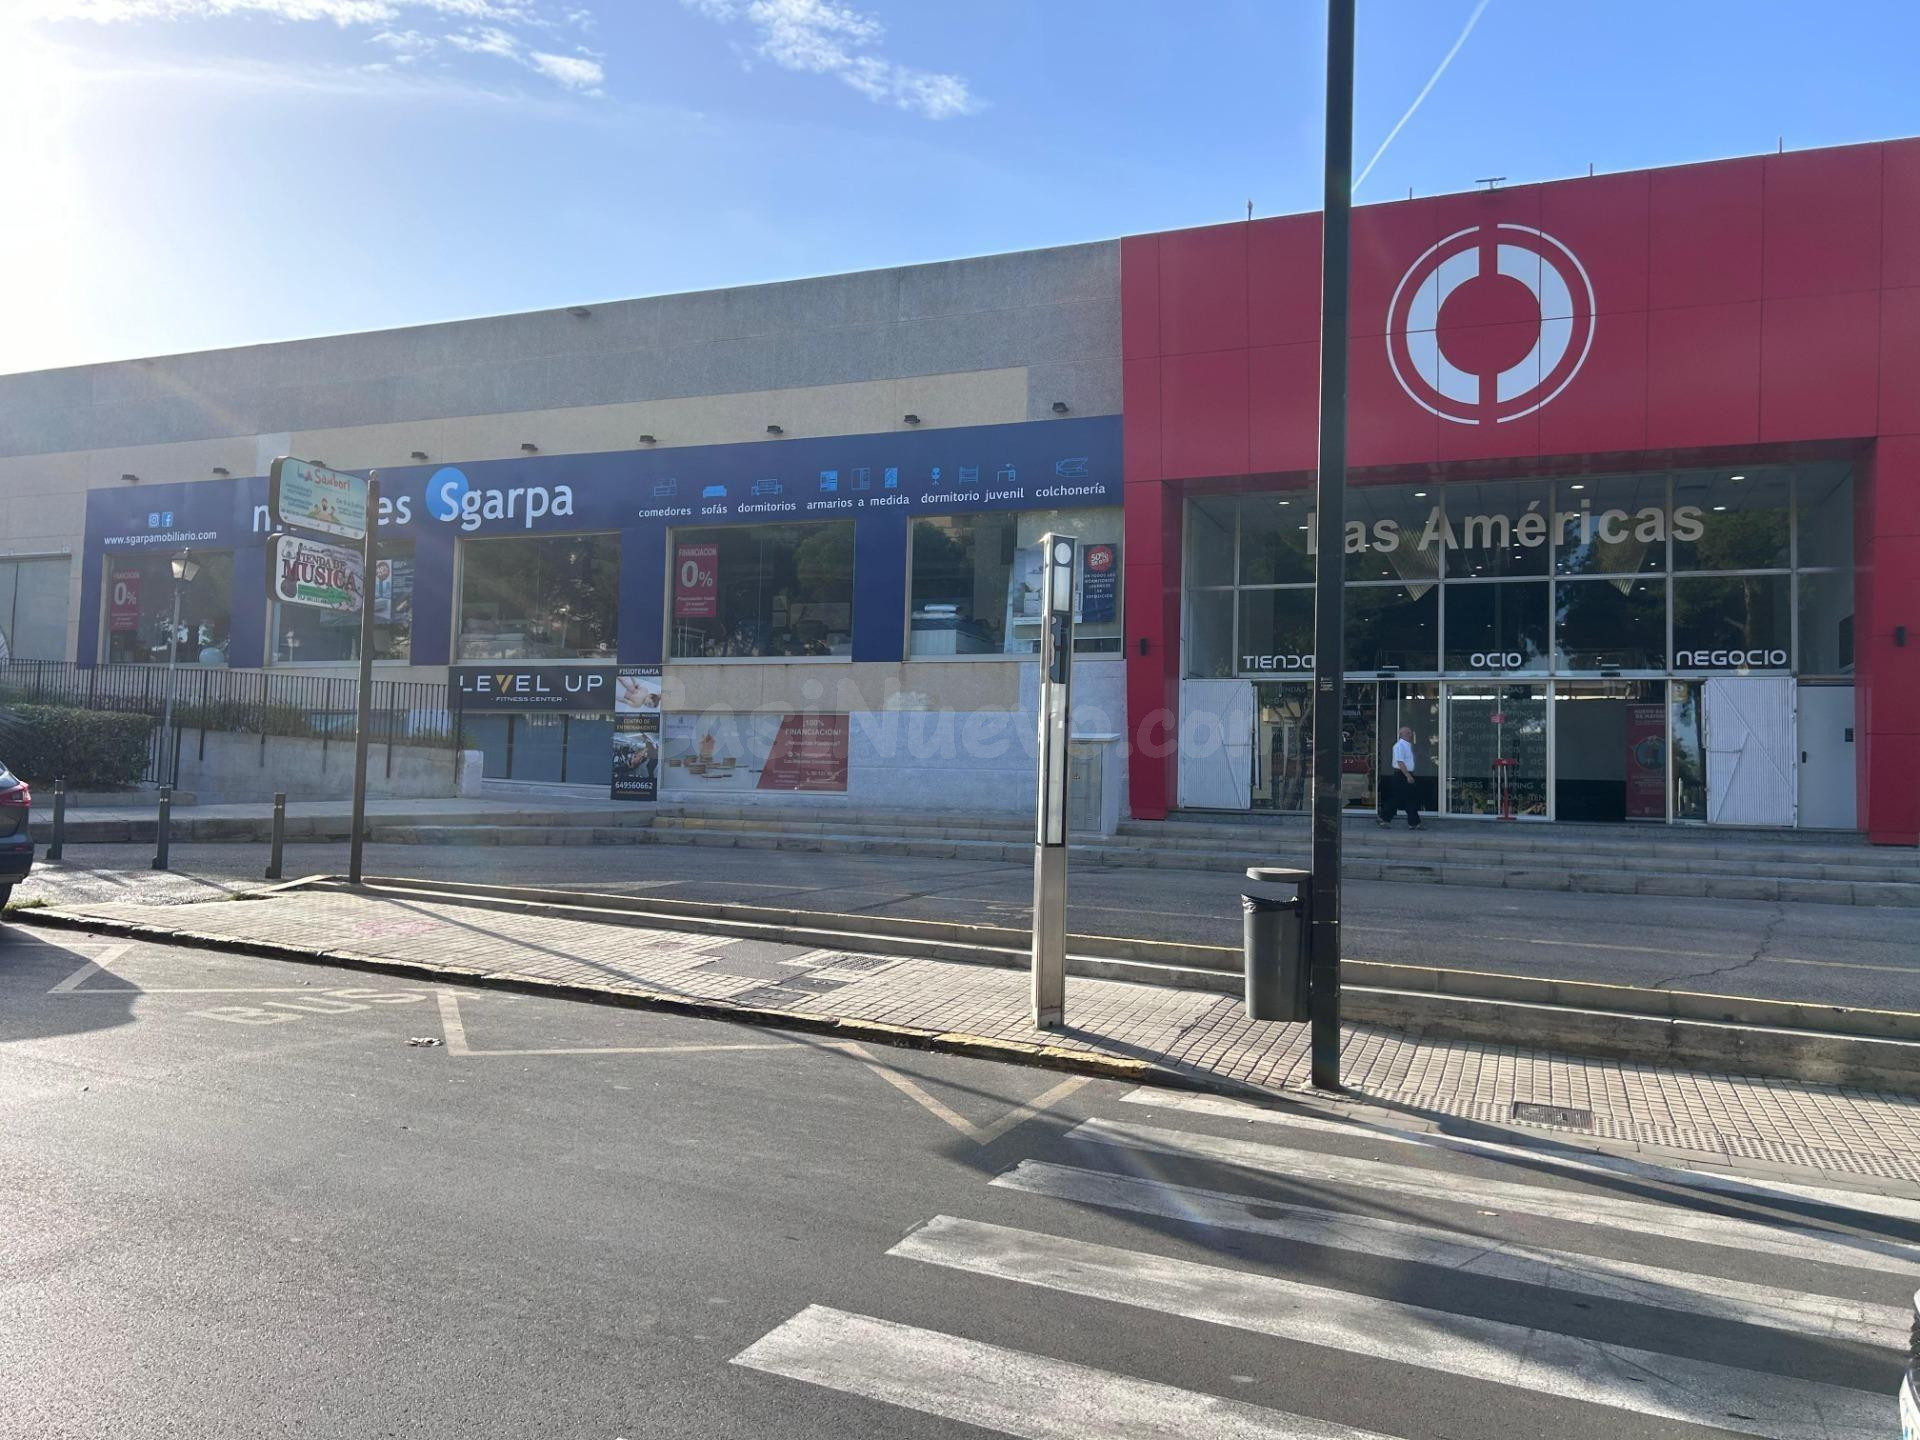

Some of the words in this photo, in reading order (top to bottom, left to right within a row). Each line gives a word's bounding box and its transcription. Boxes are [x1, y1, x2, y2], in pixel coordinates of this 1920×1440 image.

[921, 489, 980, 503] dormitorio
[984, 487, 1025, 502] juvenil
[1035, 482, 1106, 497] colchonería
[439, 481, 574, 532] Sgarpa
[701, 503, 728, 515] sofás
[737, 501, 797, 513] dormitorios
[806, 497, 853, 510] armarios
[857, 499, 865, 507] a
[870, 494, 910, 507] medida
[638, 506, 692, 518] comedores
[1417, 498, 1704, 551] Américas
[104, 531, 217, 545] www.sgarpamobiliario.com
[682, 560, 713, 588] 0%
[114, 582, 137, 605] 0%
[1470, 652, 1522, 667] OCIO
[1676, 649, 1787, 666] NEGOCIO
[459, 674, 551, 693] LEVEL
[565, 674, 603, 693] UP
